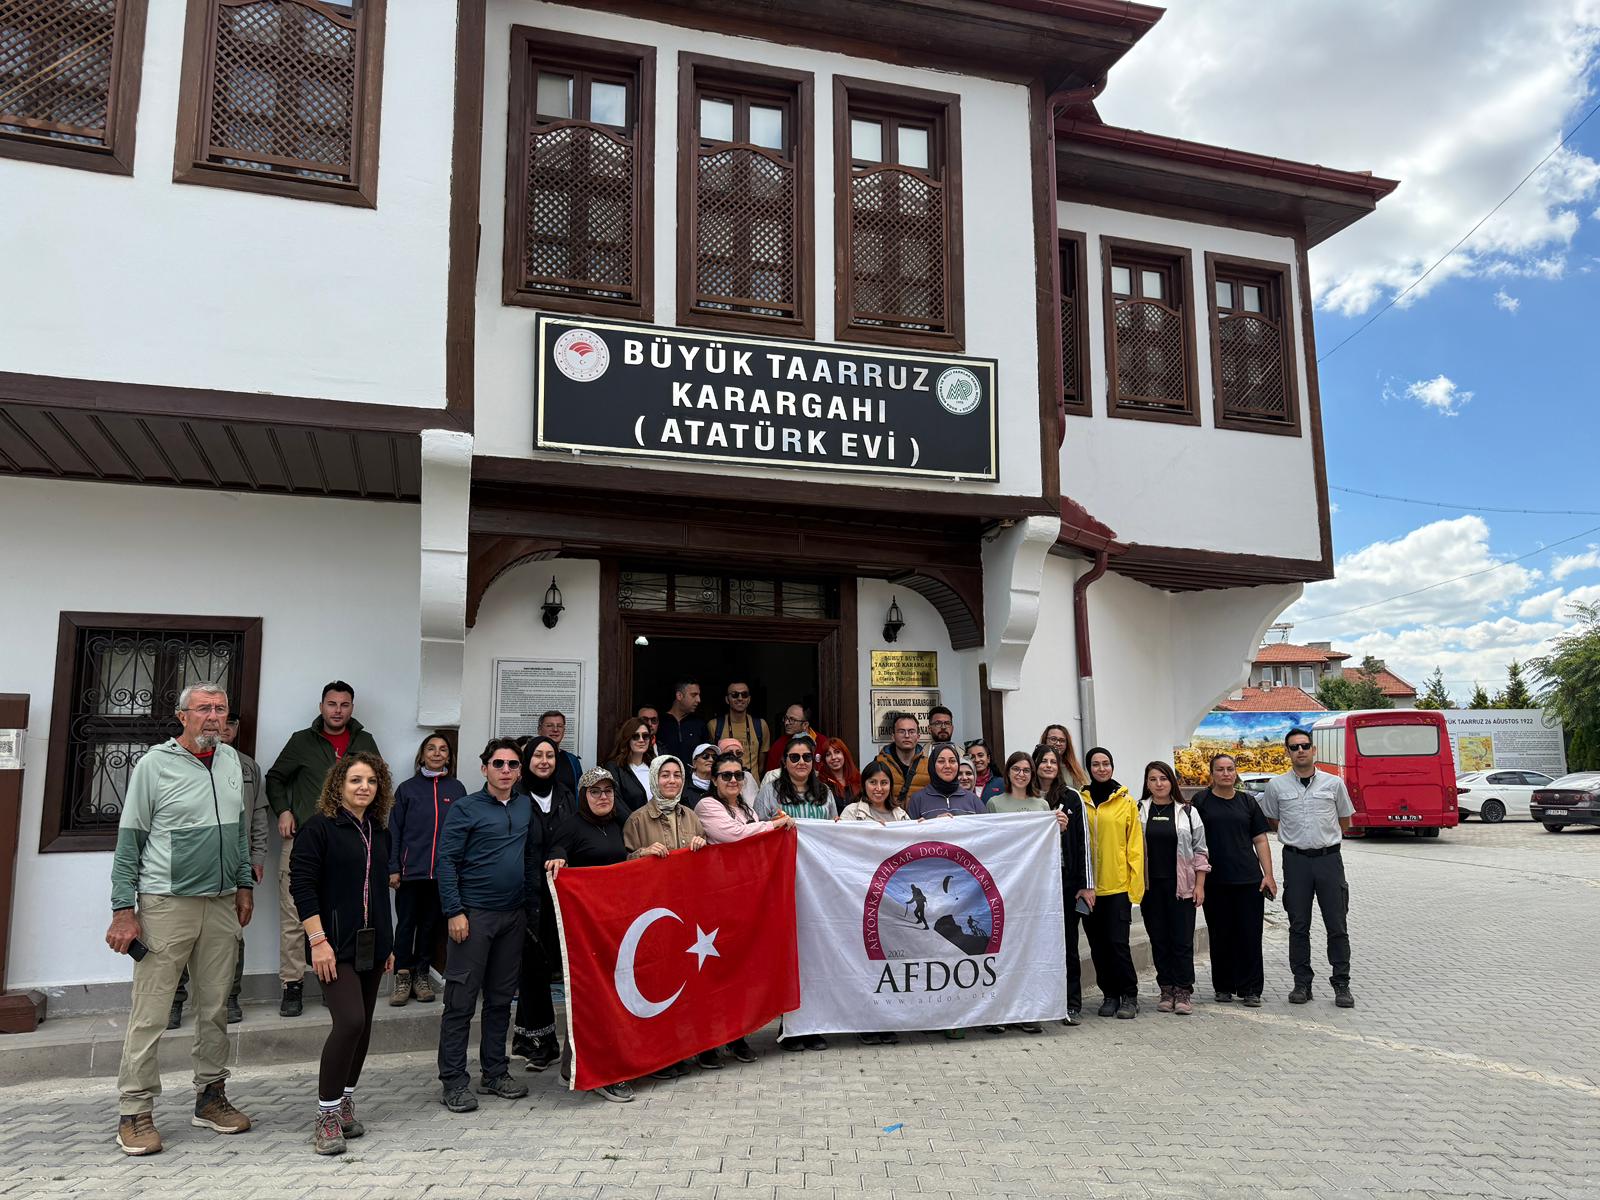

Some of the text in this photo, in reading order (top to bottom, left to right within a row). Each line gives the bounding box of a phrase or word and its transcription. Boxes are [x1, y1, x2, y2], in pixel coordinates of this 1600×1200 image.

[624, 337, 753, 377] BÜYÜK
[766, 353, 930, 392] TAARRUZ
[671, 381, 886, 423] KARARGAHI
[660, 420, 827, 456] ATATÜRK
[841, 430, 895, 460] EVİ
[1492, 717, 1519, 725] AĞUSTOS
[919, 846, 949, 857] DOĞA
[954, 852, 992, 892] SPORLARI
[873, 956, 997, 994] AFDOS
